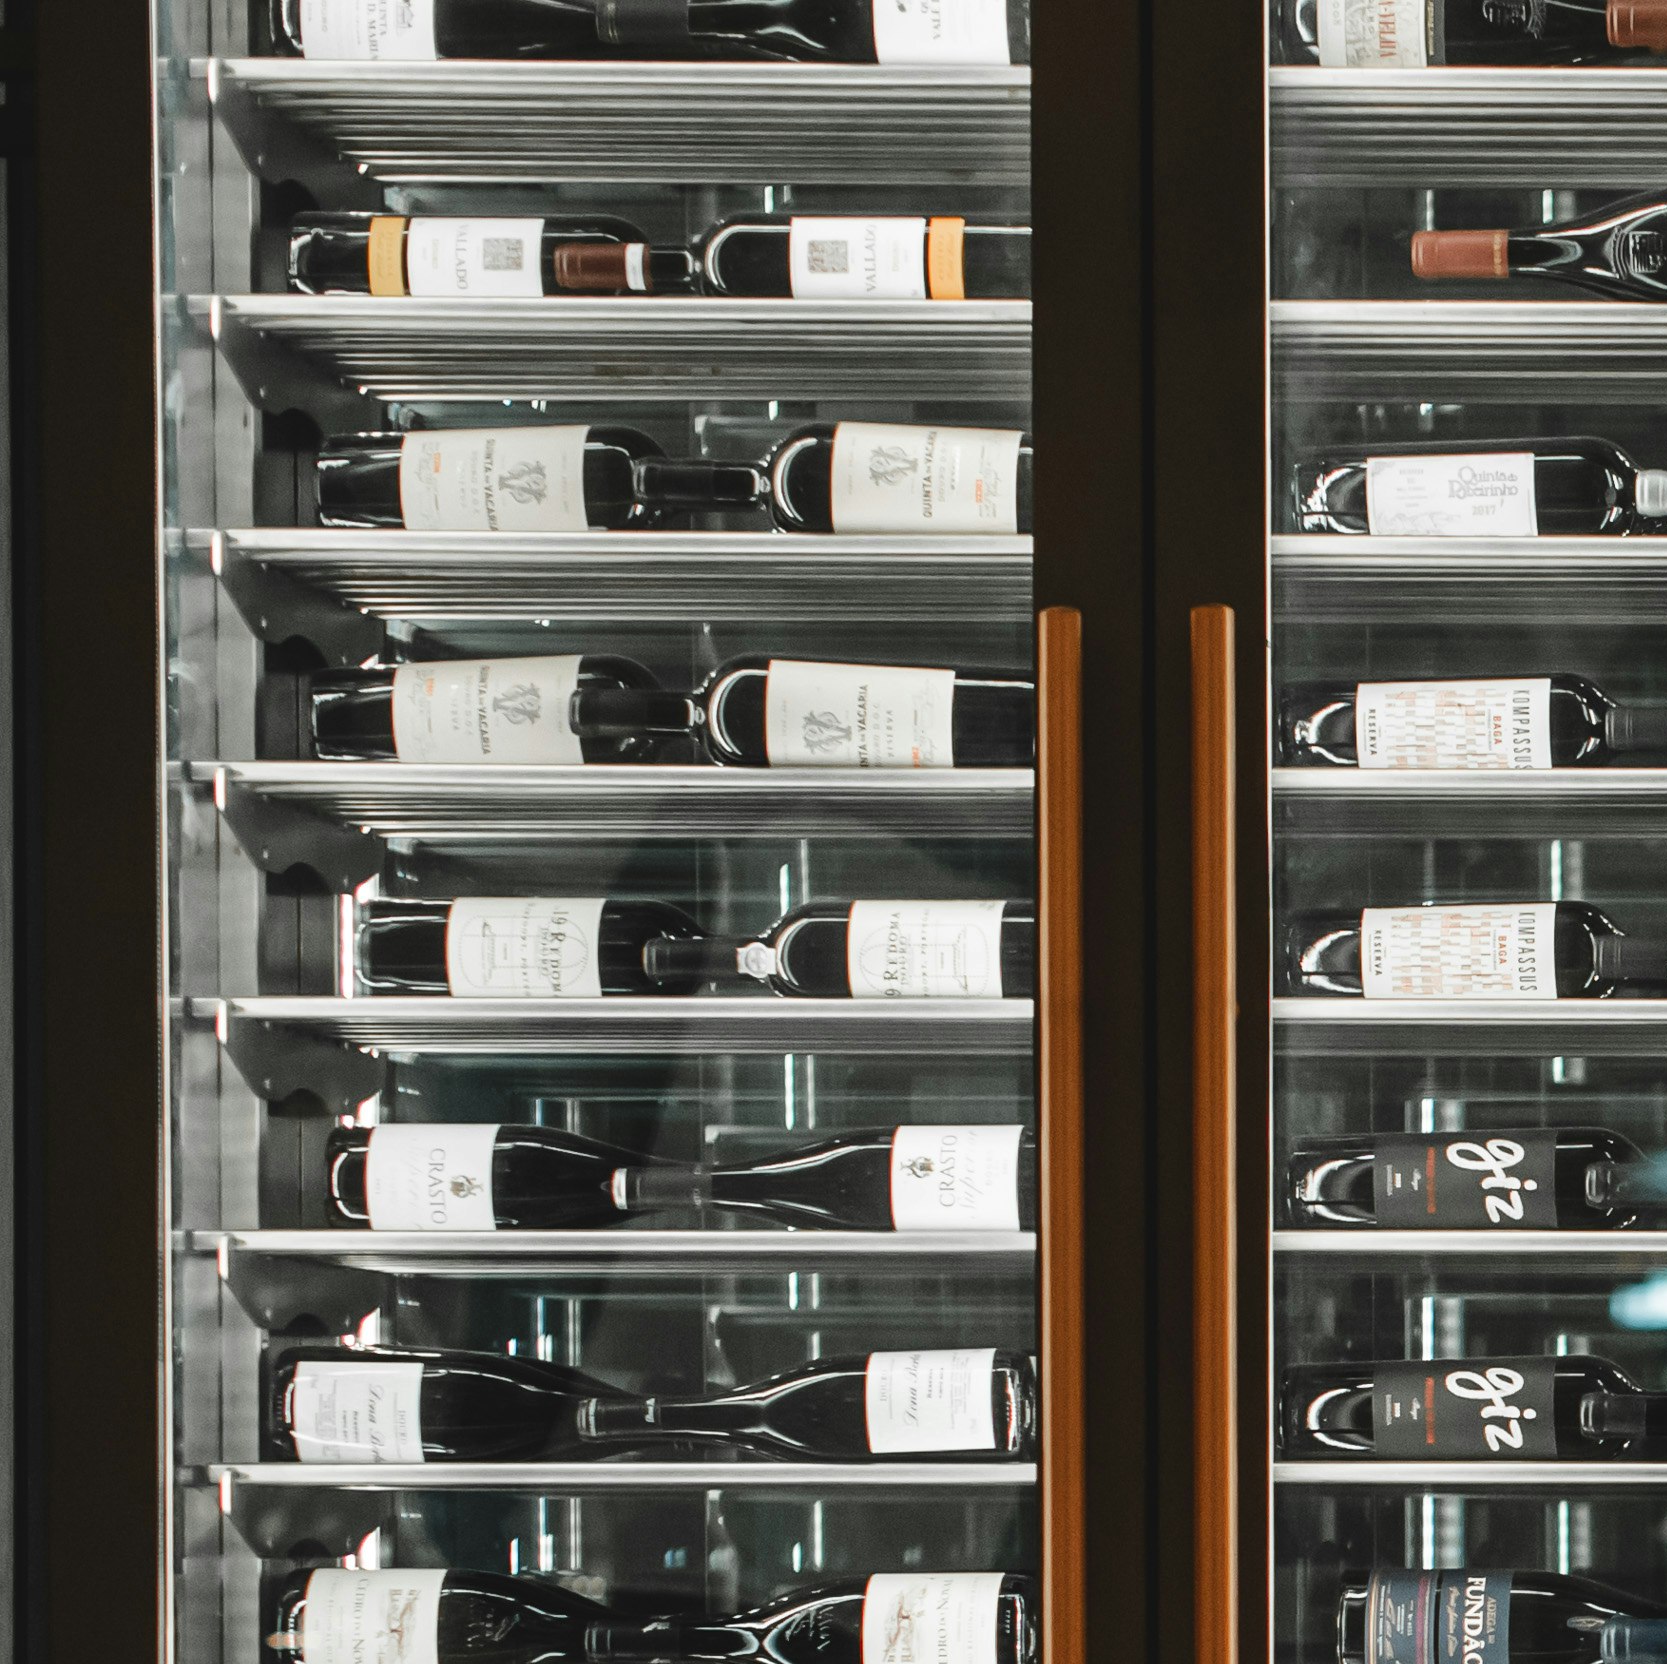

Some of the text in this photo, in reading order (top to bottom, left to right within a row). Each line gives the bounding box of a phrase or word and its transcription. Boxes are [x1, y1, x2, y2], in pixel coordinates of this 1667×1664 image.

[455, 224, 470, 291] VALLADO
[864, 225, 878, 292] VALLADO
[923, 483, 934, 518] QUINTA
[857, 685, 869, 735] VACARIA
[1367, 708, 1378, 757] RESERVA
[1493, 715, 1503, 744] BAGA
[1372, 928, 1383, 977] RESERVA
[1497, 935, 1508, 966] BAGA
[1518, 911, 1539, 992] KOMPASSUS
[428, 1147, 448, 1225] CRASTO
[938, 1136, 957, 1208] CRASTO
[1445, 1139, 1538, 1223] giz
[1444, 1367, 1537, 1452] giz
